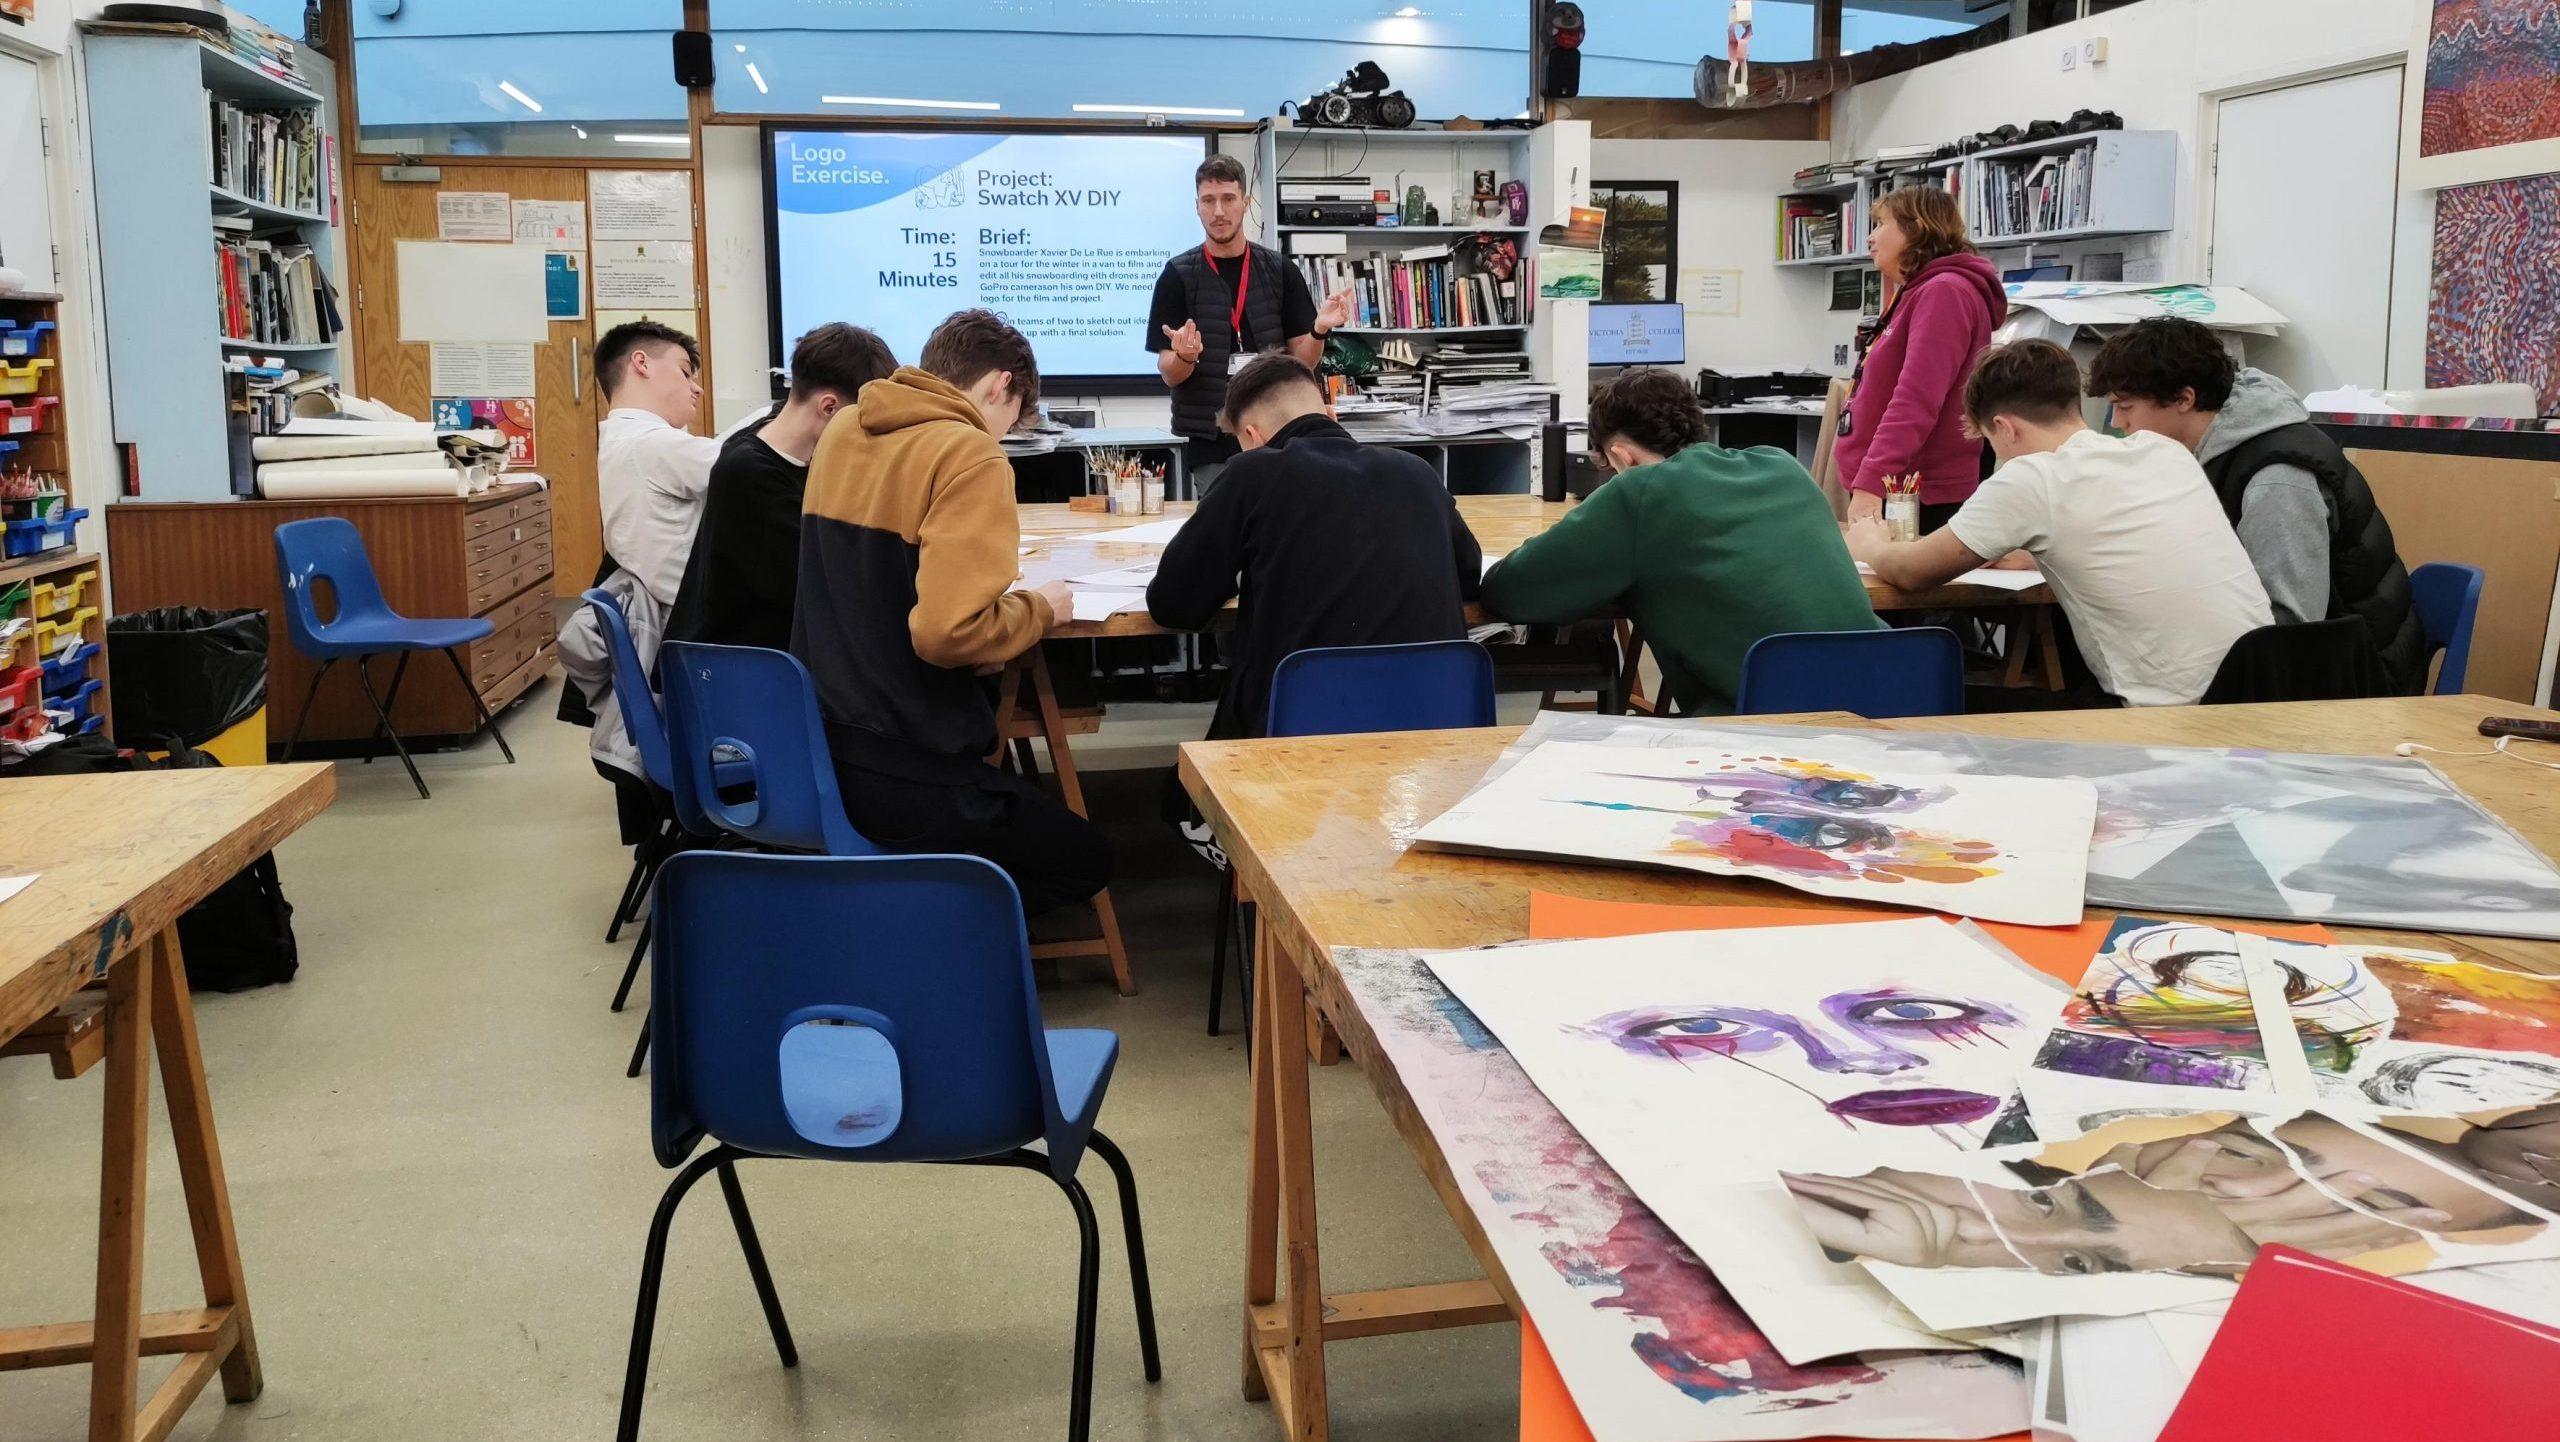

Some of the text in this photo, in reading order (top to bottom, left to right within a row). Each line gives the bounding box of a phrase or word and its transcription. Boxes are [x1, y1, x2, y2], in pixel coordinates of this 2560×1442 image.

[791, 142, 846, 165] Logo
[792, 164, 890, 184] Exercise.
[977, 169, 1053, 191] Project:
[978, 188, 1122, 207] Swatch XV DIY
[900, 227, 957, 245] Time:
[979, 227, 1032, 246] Brief:
[932, 251, 957, 268] 15
[979, 248, 1171, 259] Snowboarder Xavier De Le Rue is embarking
[1000, 260, 1018, 268] tour
[1021, 260, 1033, 268] for
[1036, 260, 1050, 268] the
[1052, 260, 1080, 268] winter
[1082, 260, 1090, 268] in
[1117, 260, 1125, 268] to
[1128, 260, 1144, 268] film
[1146, 260, 1162, 268] and
[878, 270, 958, 288] Minutes
[979, 271, 997, 279] edit
[999, 271, 1009, 279] all
[1011, 271, 1024, 279] his
[1026, 271, 1088, 281] snowboarding
[1109, 271, 1139, 279] drones
[1141, 271, 1157, 279] and
[980, 283, 1009, 291] GoPro
[1060, 283, 1073, 291] his
[1115, 283, 1129, 291] We
[1132, 283, 1153, 291] need
[980, 294, 1103, 304] logo for the film and project.
[1017, 316, 1044, 325] teams
[1046, 316, 1055, 325] of
[1057, 316, 1074, 325] two
[1076, 316, 1085, 325] to
[1087, 316, 1115, 325] sketch
[1117, 316, 1131, 325] out
[1133, 316, 1150, 325] ide
[1026, 330, 1038, 338] up
[1040, 328, 1059, 337] with
[1068, 328, 1087, 337] final
[1089, 328, 1126, 337] solution.
